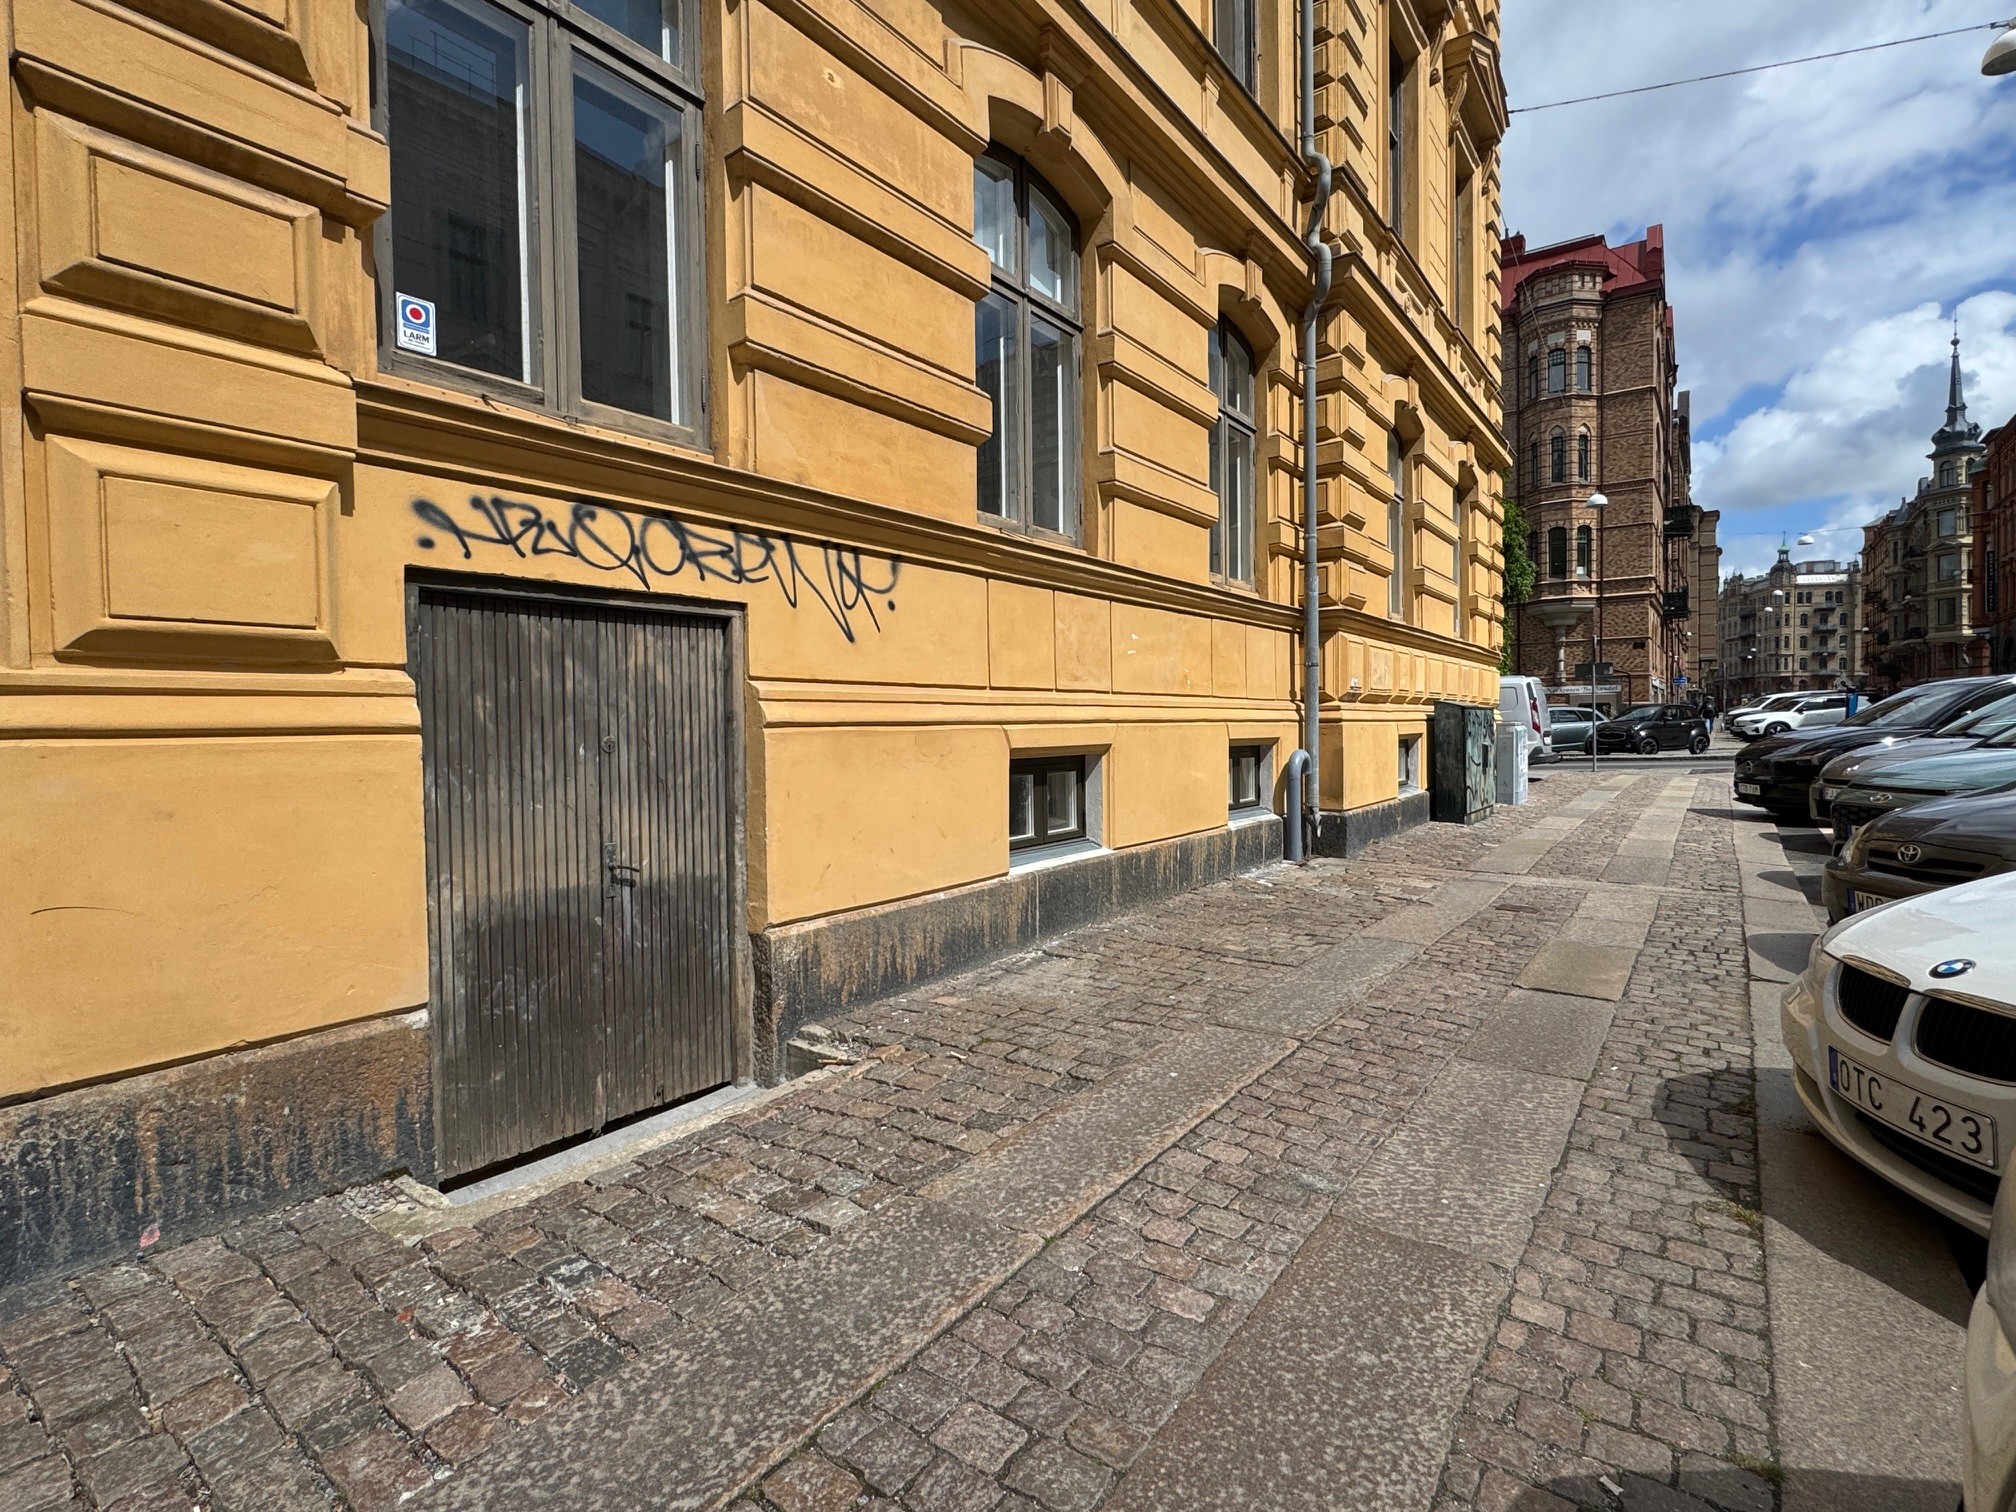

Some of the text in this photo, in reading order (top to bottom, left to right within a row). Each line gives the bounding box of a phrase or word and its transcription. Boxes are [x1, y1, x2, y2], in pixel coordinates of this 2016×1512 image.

[403, 329, 430, 344] LARM
[1840, 1060, 1982, 1154] OTC 423
